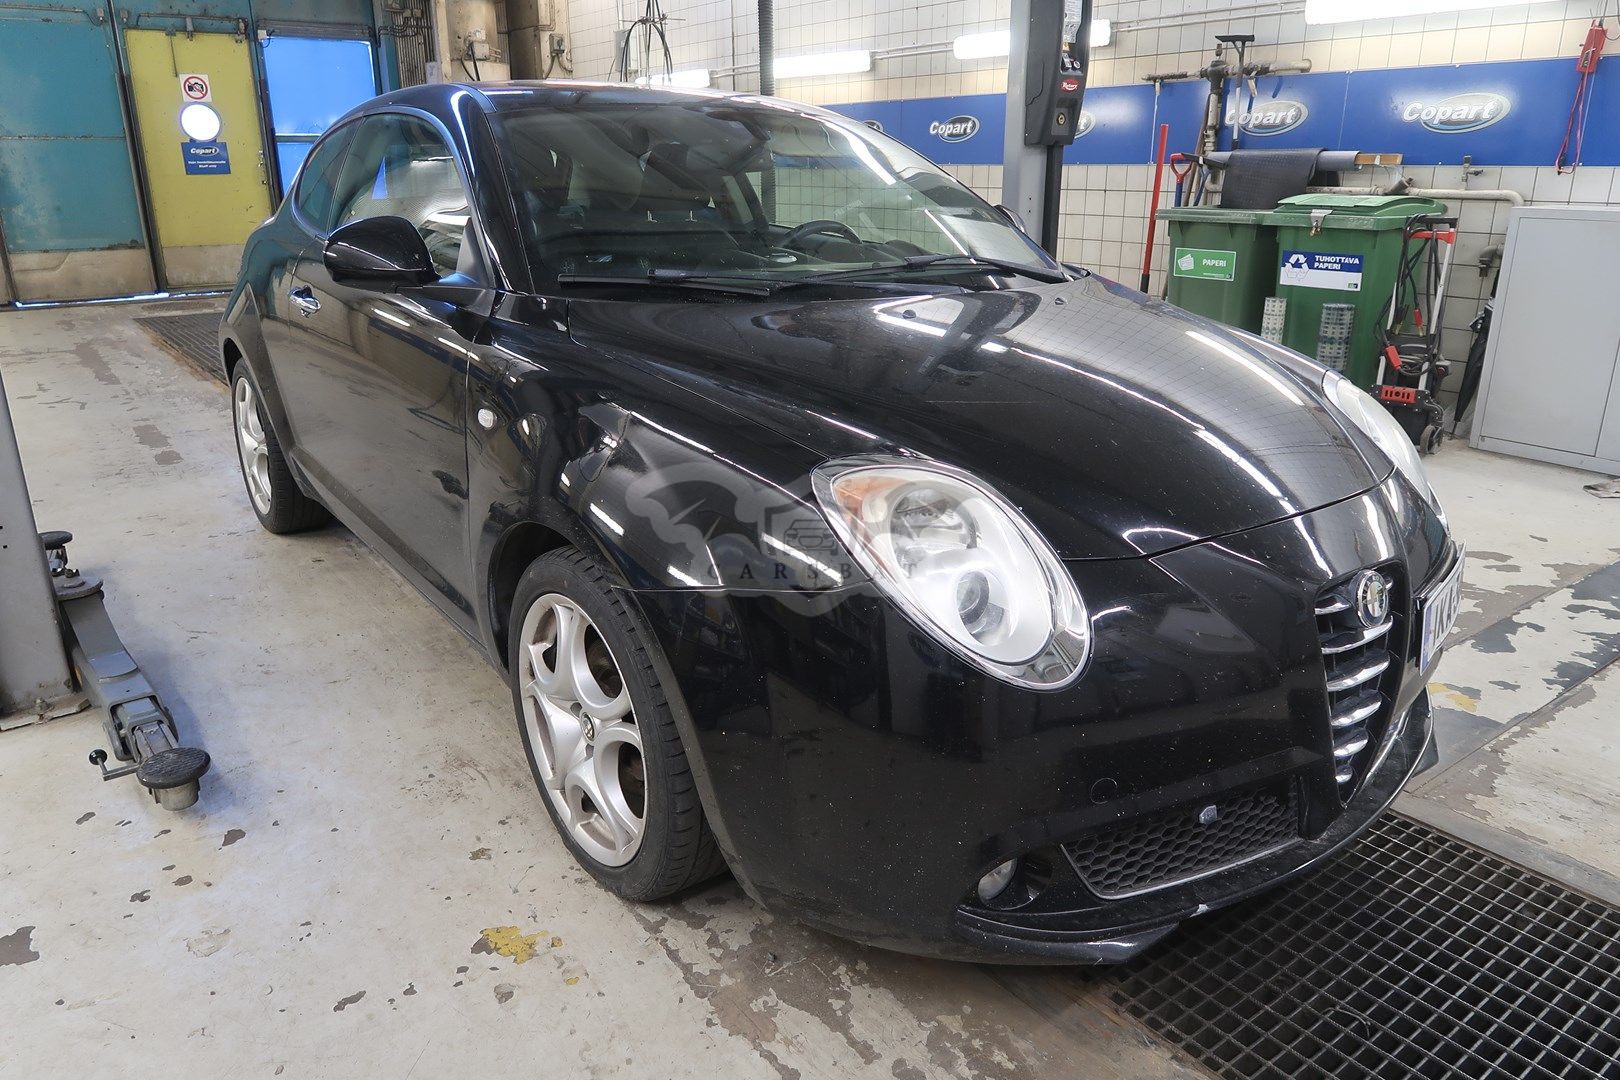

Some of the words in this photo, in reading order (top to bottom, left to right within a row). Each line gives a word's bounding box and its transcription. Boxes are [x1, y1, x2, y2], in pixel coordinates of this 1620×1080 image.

[1403, 100, 1496, 124] Copart
[929, 120, 973, 137] Copart
[1202, 258, 1227, 267] PAPERI
[1315, 255, 1359, 265] TUHOTTAVA
